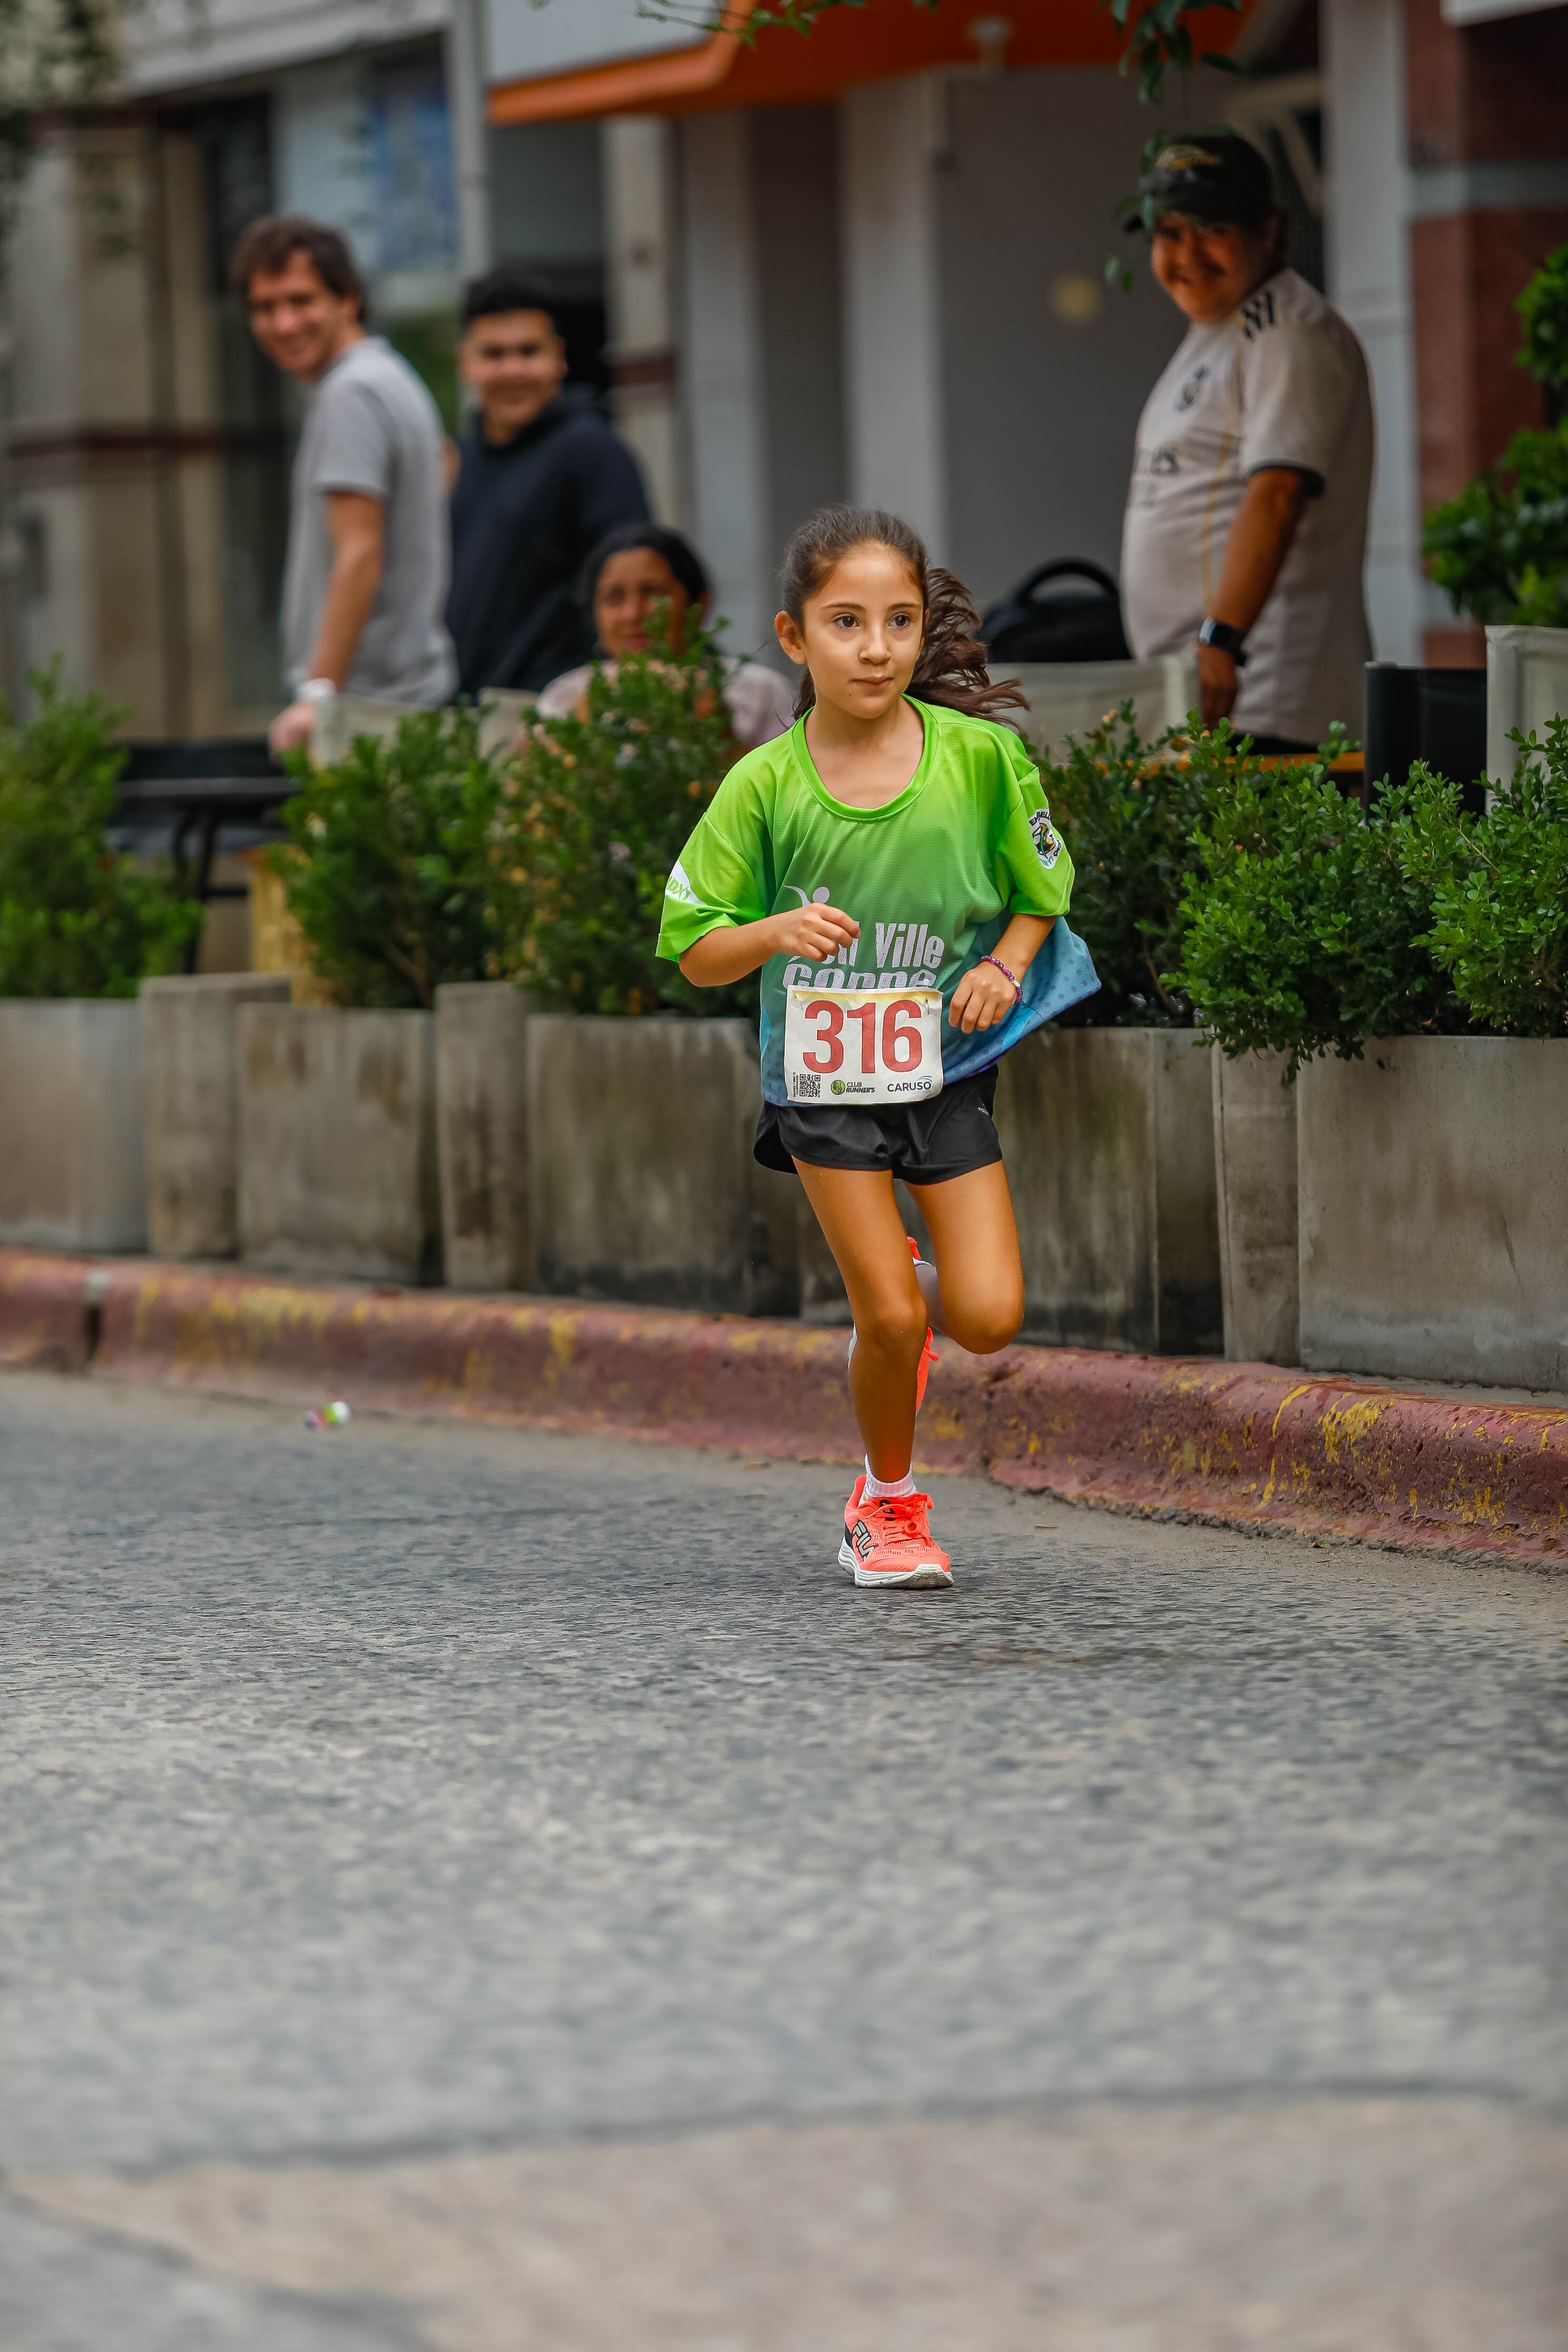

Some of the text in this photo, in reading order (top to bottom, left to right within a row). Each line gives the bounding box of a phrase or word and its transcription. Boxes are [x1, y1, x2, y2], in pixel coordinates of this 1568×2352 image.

[875, 922, 945, 968] Ville
[803, 999, 922, 1074] 316
[887, 1081, 932, 1092] CARUSO
